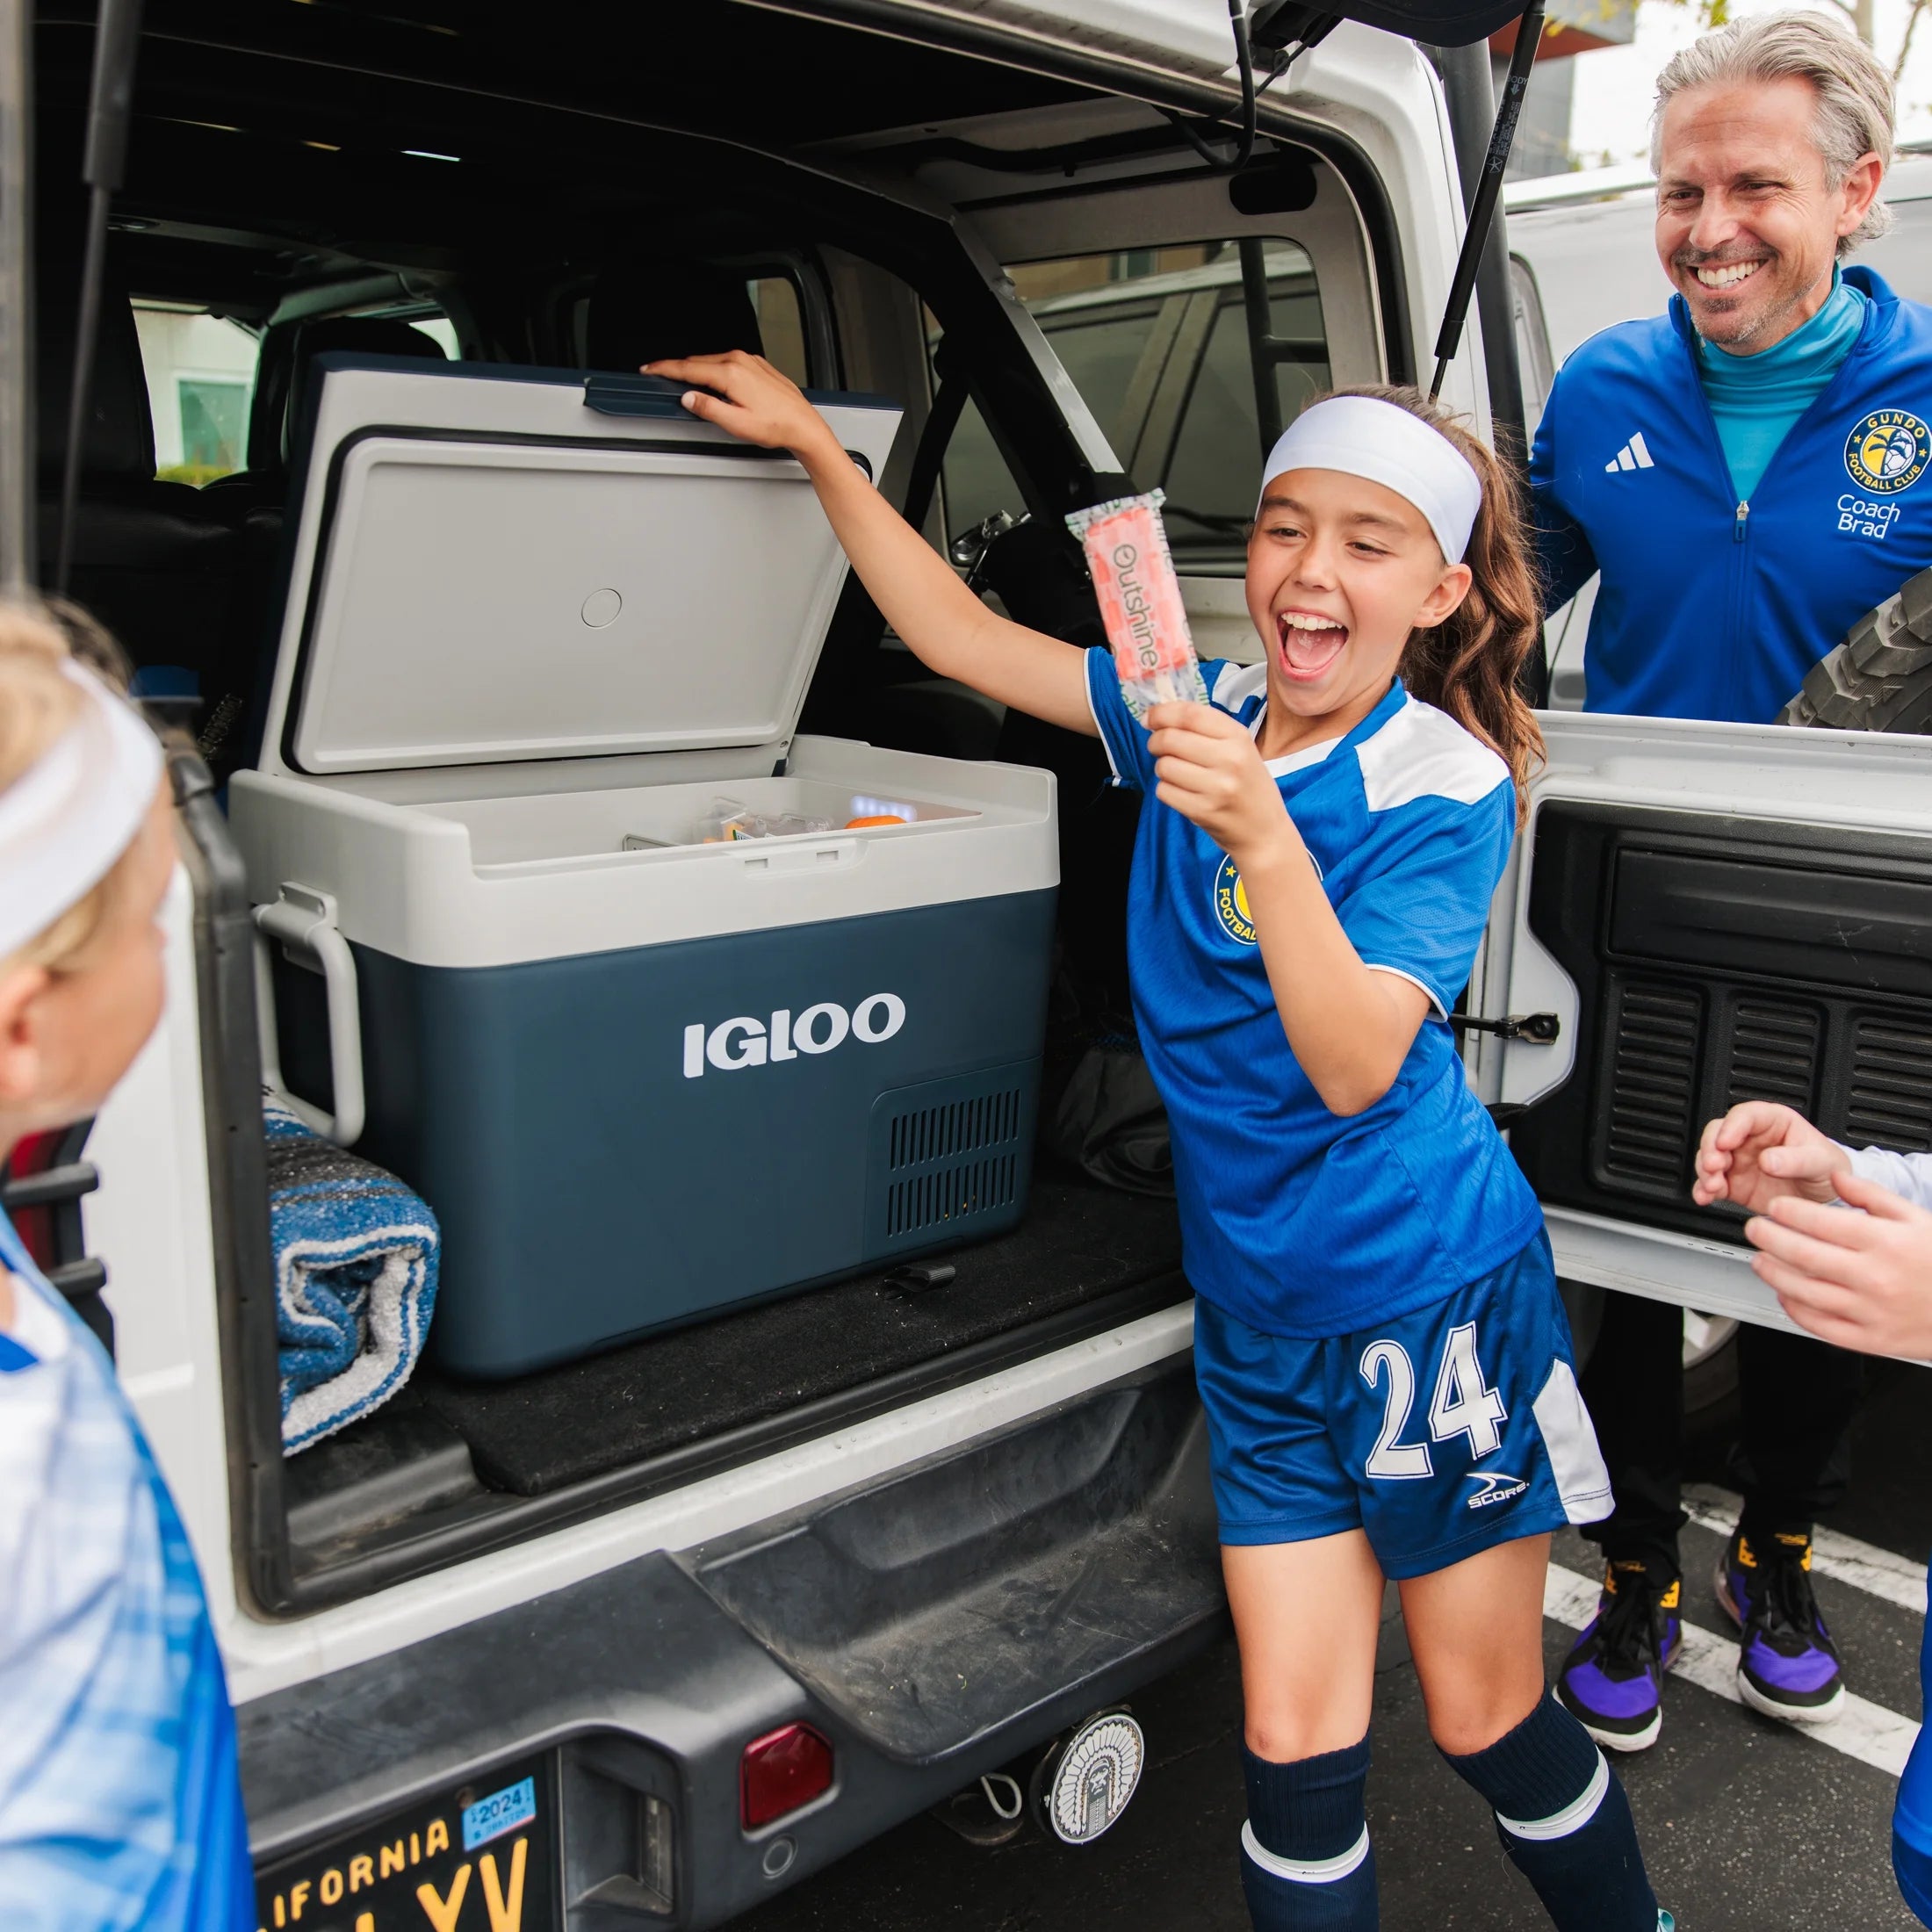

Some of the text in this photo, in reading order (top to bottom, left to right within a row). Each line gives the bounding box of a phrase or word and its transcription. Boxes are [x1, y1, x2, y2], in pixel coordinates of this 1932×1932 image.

[1867, 413, 1926, 439] GUNDO
[1849, 452, 1921, 490] FOOTBALL CLUB
[1837, 494, 1901, 523] Coach
[1837, 512, 1889, 539] Brad
[1113, 544, 1158, 667] Outshine
[1219, 888, 1257, 941] FOOTBAL
[683, 992, 906, 1078] IGLOO
[1359, 1320, 1508, 1479] 24
[1467, 1480, 1526, 1509] SCORE
[479, 1789, 522, 1824] 2024
[263, 1819, 449, 1929] IFORNIA
